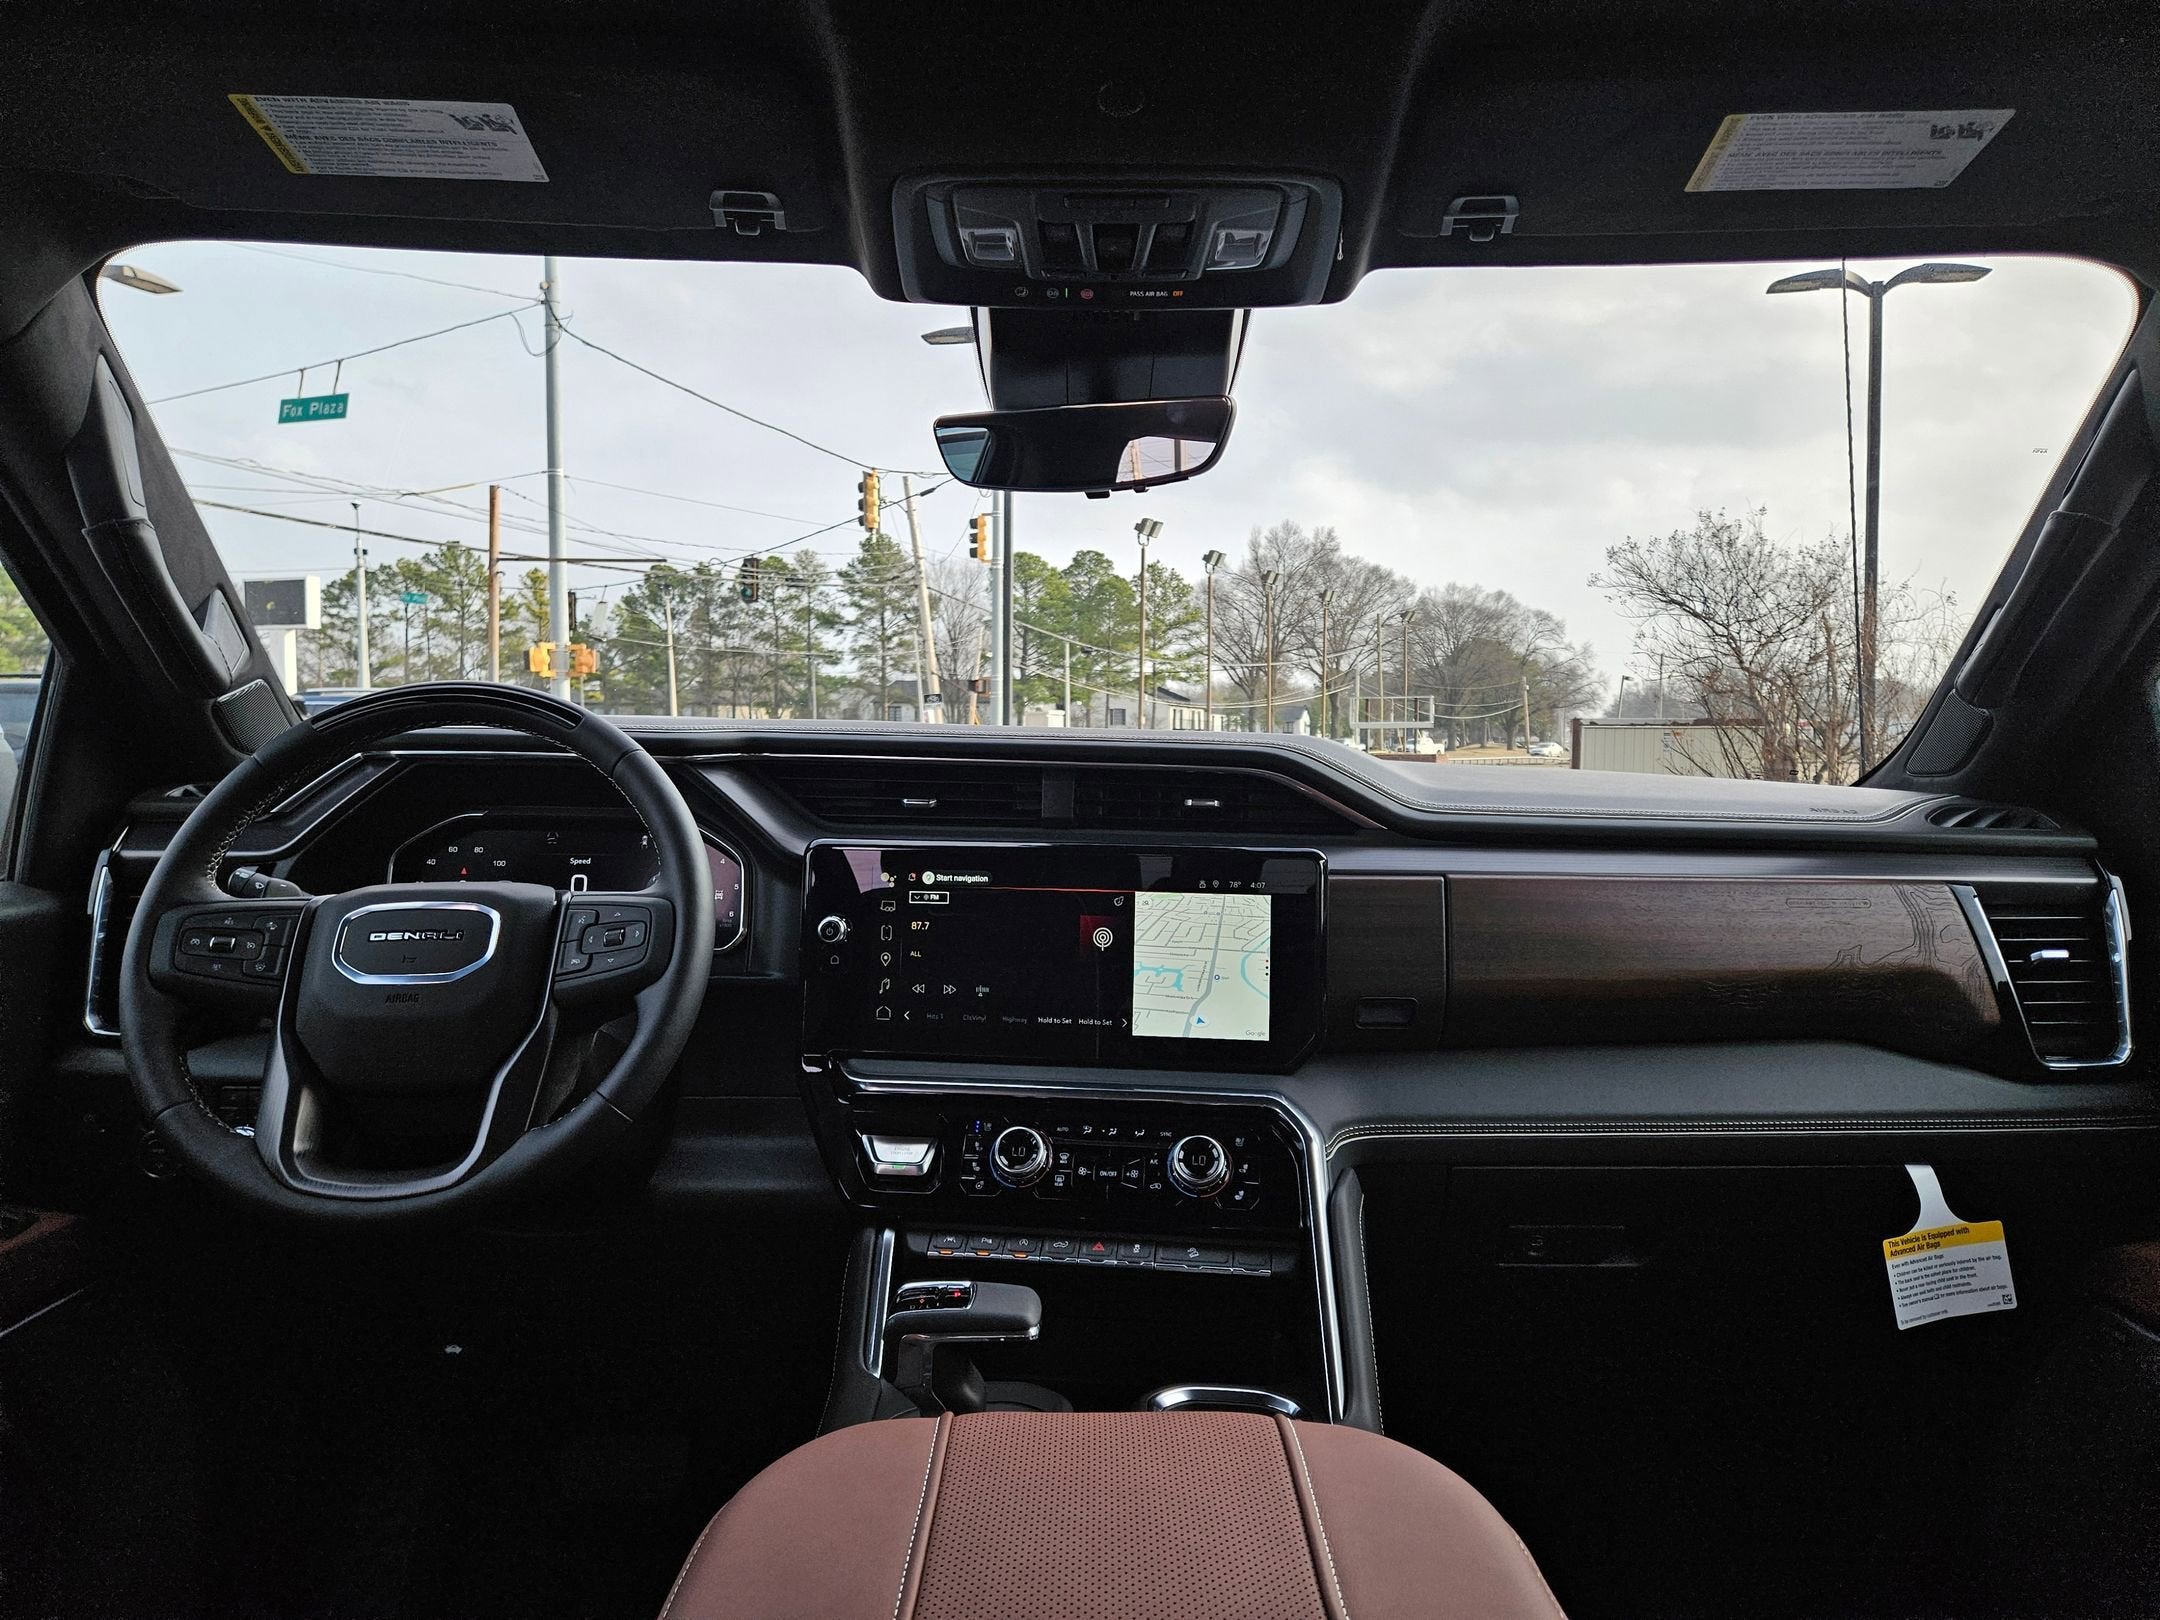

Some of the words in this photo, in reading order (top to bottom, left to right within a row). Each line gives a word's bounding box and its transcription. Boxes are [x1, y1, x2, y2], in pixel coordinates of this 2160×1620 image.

[283, 404, 303, 418] Fox
[309, 401, 344, 416] Plaza
[474, 846, 484, 854] 80
[570, 857, 592, 866] Speed
[936, 874, 953, 882] Start
[953, 874, 989, 884] navigation
[1229, 881, 1242, 889] 78°
[729, 910, 734, 918] 6
[911, 921, 930, 930] 87.7
[369, 931, 464, 942] DENALI
[384, 993, 420, 1004] AIRBAG
[1037, 1016, 1053, 1024] Hold
[1061, 1017, 1072, 1025] Set
[1900, 1236, 1920, 1245] Vehicle
[1927, 1229, 1954, 1240] Equipped
[1956, 1226, 1969, 1234] with
[1890, 1245, 1916, 1256] Advanced
[1926, 1240, 1940, 1250] Bags
